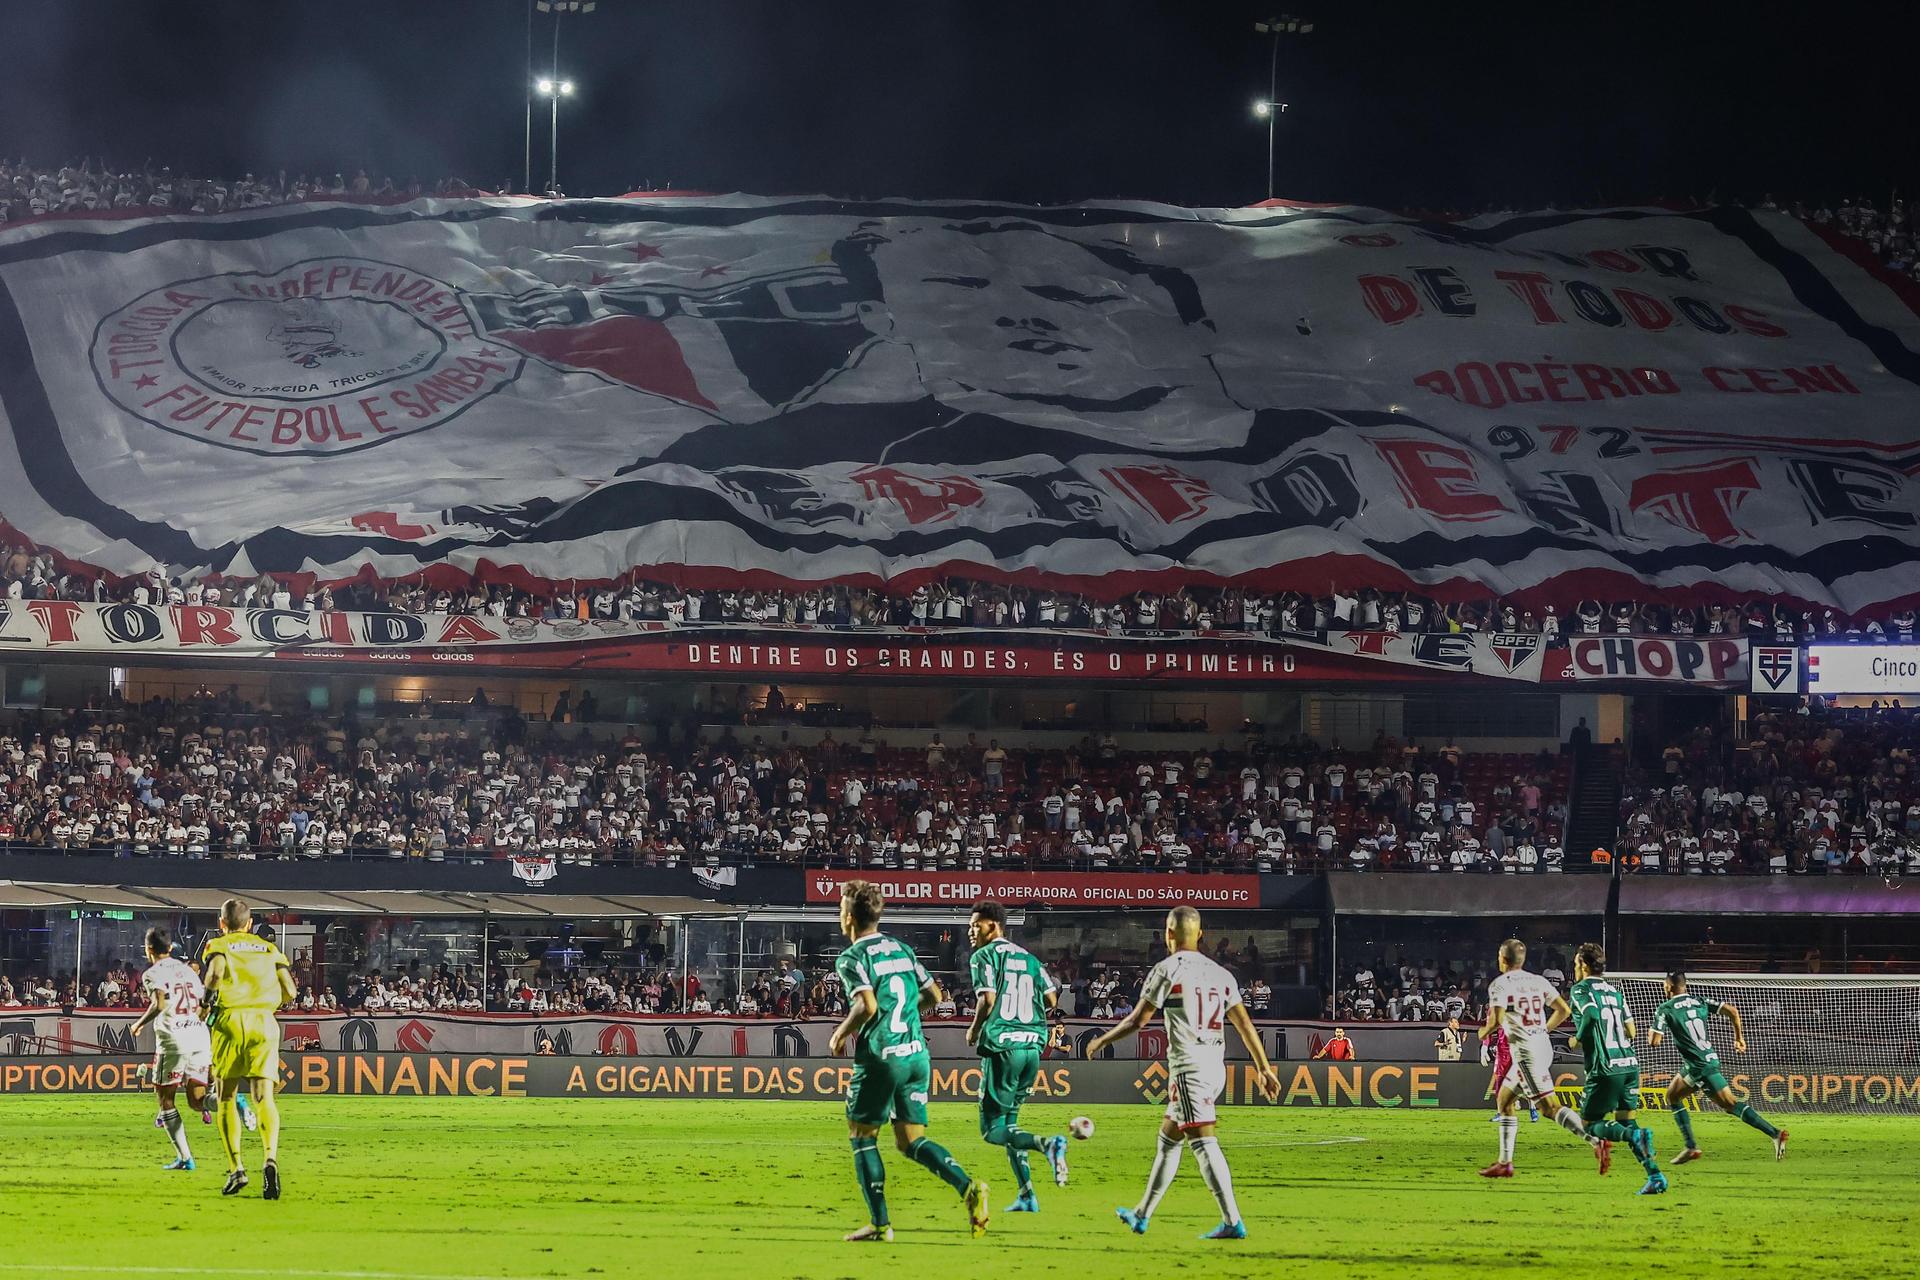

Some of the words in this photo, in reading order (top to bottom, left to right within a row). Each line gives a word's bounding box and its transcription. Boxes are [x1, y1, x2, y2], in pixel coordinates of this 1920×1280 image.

[1356, 266, 1477, 326] DE
[1494, 270, 1790, 337] TODOS
[107, 290, 212, 379] TORCIDA
[233, 264, 475, 342] DEPENDENT
[251, 383, 319, 393] TORCIDA
[328, 368, 395, 388] TRICOL
[1703, 364, 1862, 395] CENI
[142, 384, 363, 445] FUTEBOL
[358, 396, 398, 433] E
[390, 355, 507, 420] SAMBA
[26, 600, 503, 646] TORCIDA
[432, 653, 474, 661] adidas
[688, 644, 801, 666] DENTRE
[825, 648, 858, 667] OS
[879, 648, 1029, 669] GRANDES,
[1053, 648, 1084, 671] ÉS
[1109, 653, 1122, 671] O
[1146, 653, 1296, 673] PRIMEIRO
[1494, 634, 1537, 648] SPFC
[1576, 639, 1739, 679] CHOPP
[1872, 657, 1917, 676] Cinco
[836, 882, 932, 898] TOLOR
[938, 883, 981, 898] CHIP
[986, 887, 994, 897] A
[998, 887, 1077, 899] OPERADORA
[1083, 888, 1133, 900] OFICIAL
[1137, 888, 1154, 899] DO
[1158, 886, 1183, 899] SÃO
[1186, 889, 1228, 901] PAULO
[1232, 890, 1249, 901] FC
[889, 976, 908, 1033] 2
[1000, 972, 1035, 1024] 30
[1195, 987, 1222, 1030] 12
[0, 1063, 156, 1091] PTOMOE
[302, 1056, 528, 1096] BINANCE
[566, 1065, 587, 1093] A
[596, 1066, 733, 1093] GIGANTE
[744, 1066, 804, 1094] DAS
[1225, 1065, 1440, 1106] INANCE
[1761, 1074, 1920, 1104] CRIPTOM
